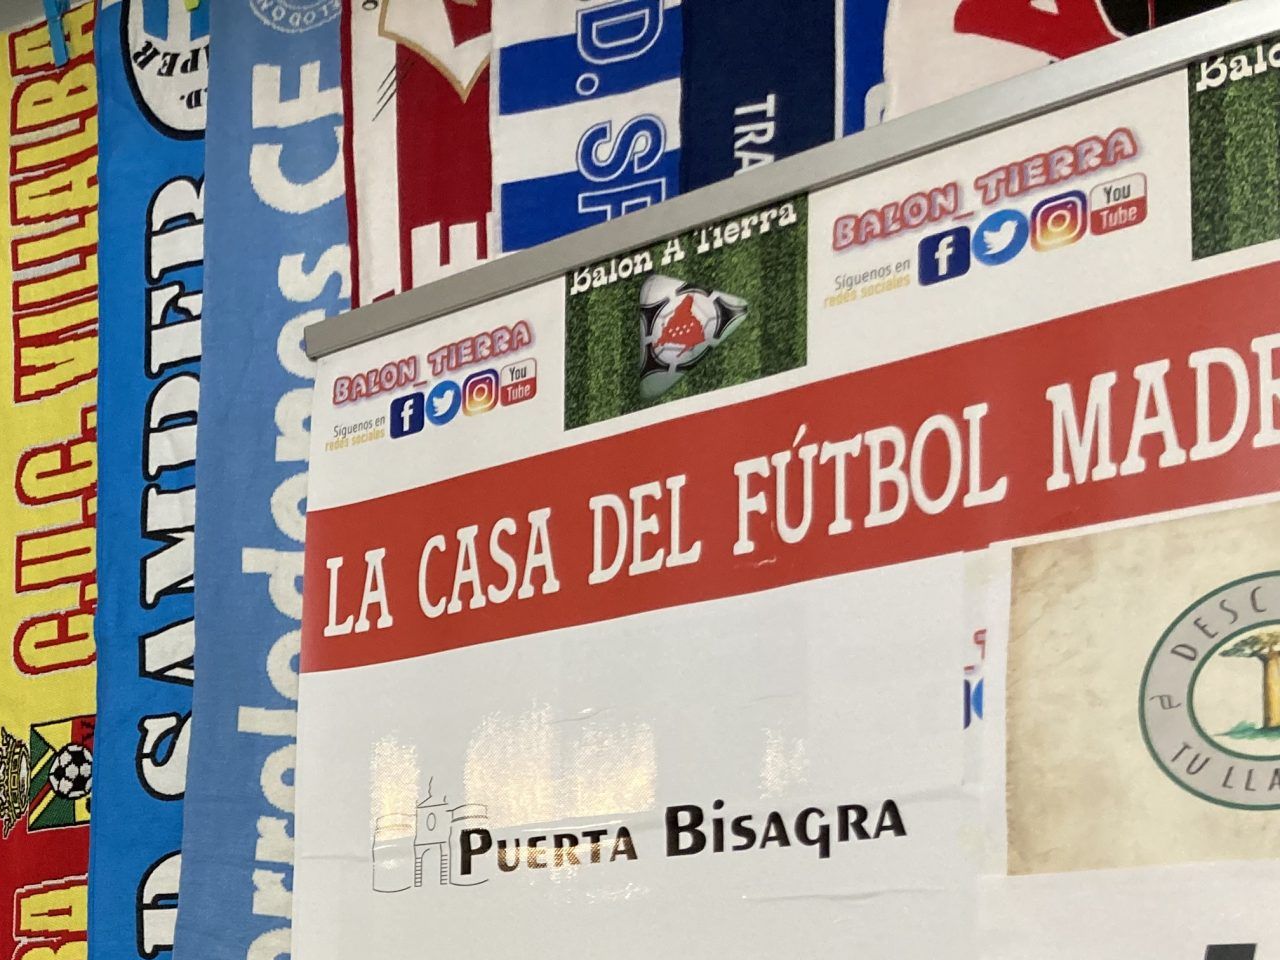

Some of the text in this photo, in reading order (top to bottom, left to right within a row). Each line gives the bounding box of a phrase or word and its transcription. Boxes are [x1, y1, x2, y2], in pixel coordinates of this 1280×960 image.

[1099, 184, 1139, 231] You Tube
[833, 257, 911, 292] Síguenos en
[506, 365, 532, 401] You Tube
[323, 554, 393, 640] LA
[417, 503, 561, 620] CASA
[588, 472, 702, 586] DEL
[733, 402, 1008, 557] FÚTBOL
